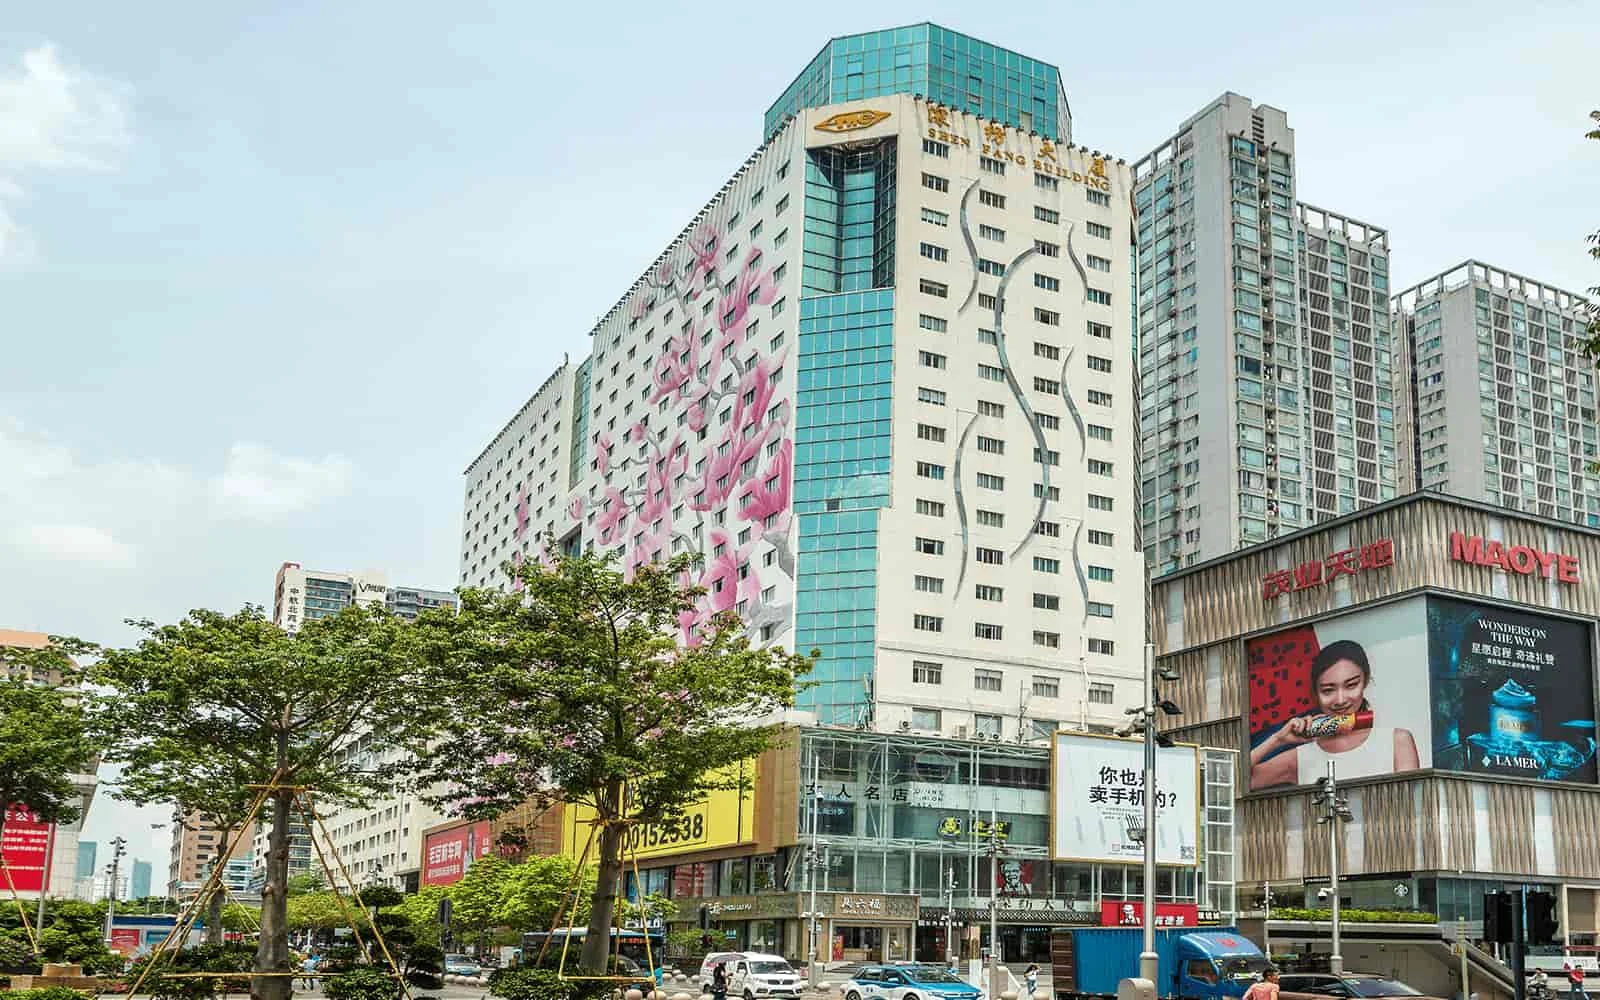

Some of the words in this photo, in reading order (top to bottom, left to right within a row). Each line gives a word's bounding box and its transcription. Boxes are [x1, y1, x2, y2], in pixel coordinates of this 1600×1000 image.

[928, 128, 970, 146] SHEN
[982, 143, 1026, 166] FANG
[1033, 159, 1110, 191] BUILDING
[1263, 538, 1393, 600] 茂业天地
[1451, 531, 1581, 584] MAOYE
[1478, 619, 1530, 637] WONDERS
[1531, 628, 1547, 639] ON
[1490, 631, 1513, 644] THE
[1514, 635, 1537, 647] WAY
[1495, 754, 1512, 767] LA
[1513, 756, 1538, 769] MER
